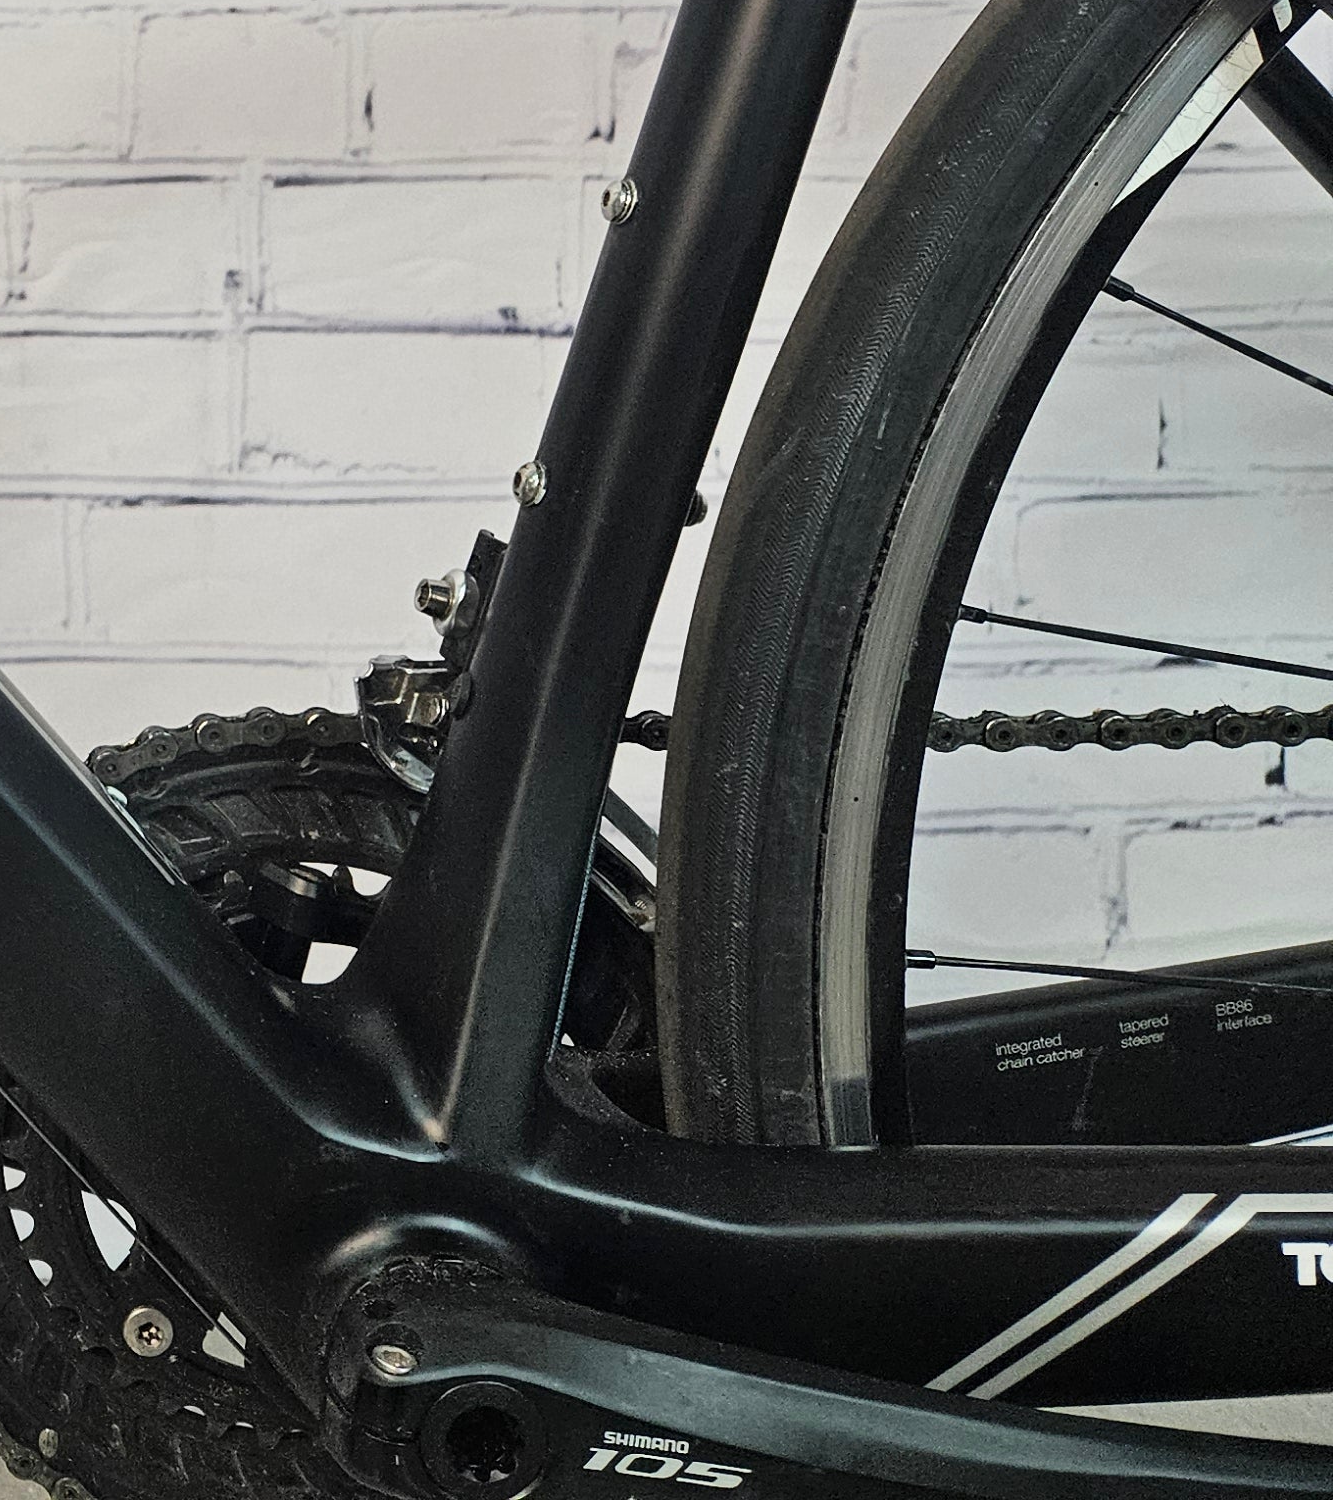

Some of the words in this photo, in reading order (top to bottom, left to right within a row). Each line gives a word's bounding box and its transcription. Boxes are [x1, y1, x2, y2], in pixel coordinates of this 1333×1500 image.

[1215, 999, 1253, 1016] BB86
[1119, 1013, 1170, 1034] tapered
[1217, 1014, 1273, 1032] interface
[995, 1033, 1062, 1057] integrated
[1121, 1032, 1165, 1049] steerer
[997, 1056, 1034, 1072] chain
[1036, 1046, 1087, 1065] catcher
[603, 1431, 690, 1454] SHIMANO
[583, 1447, 753, 1489] 105
